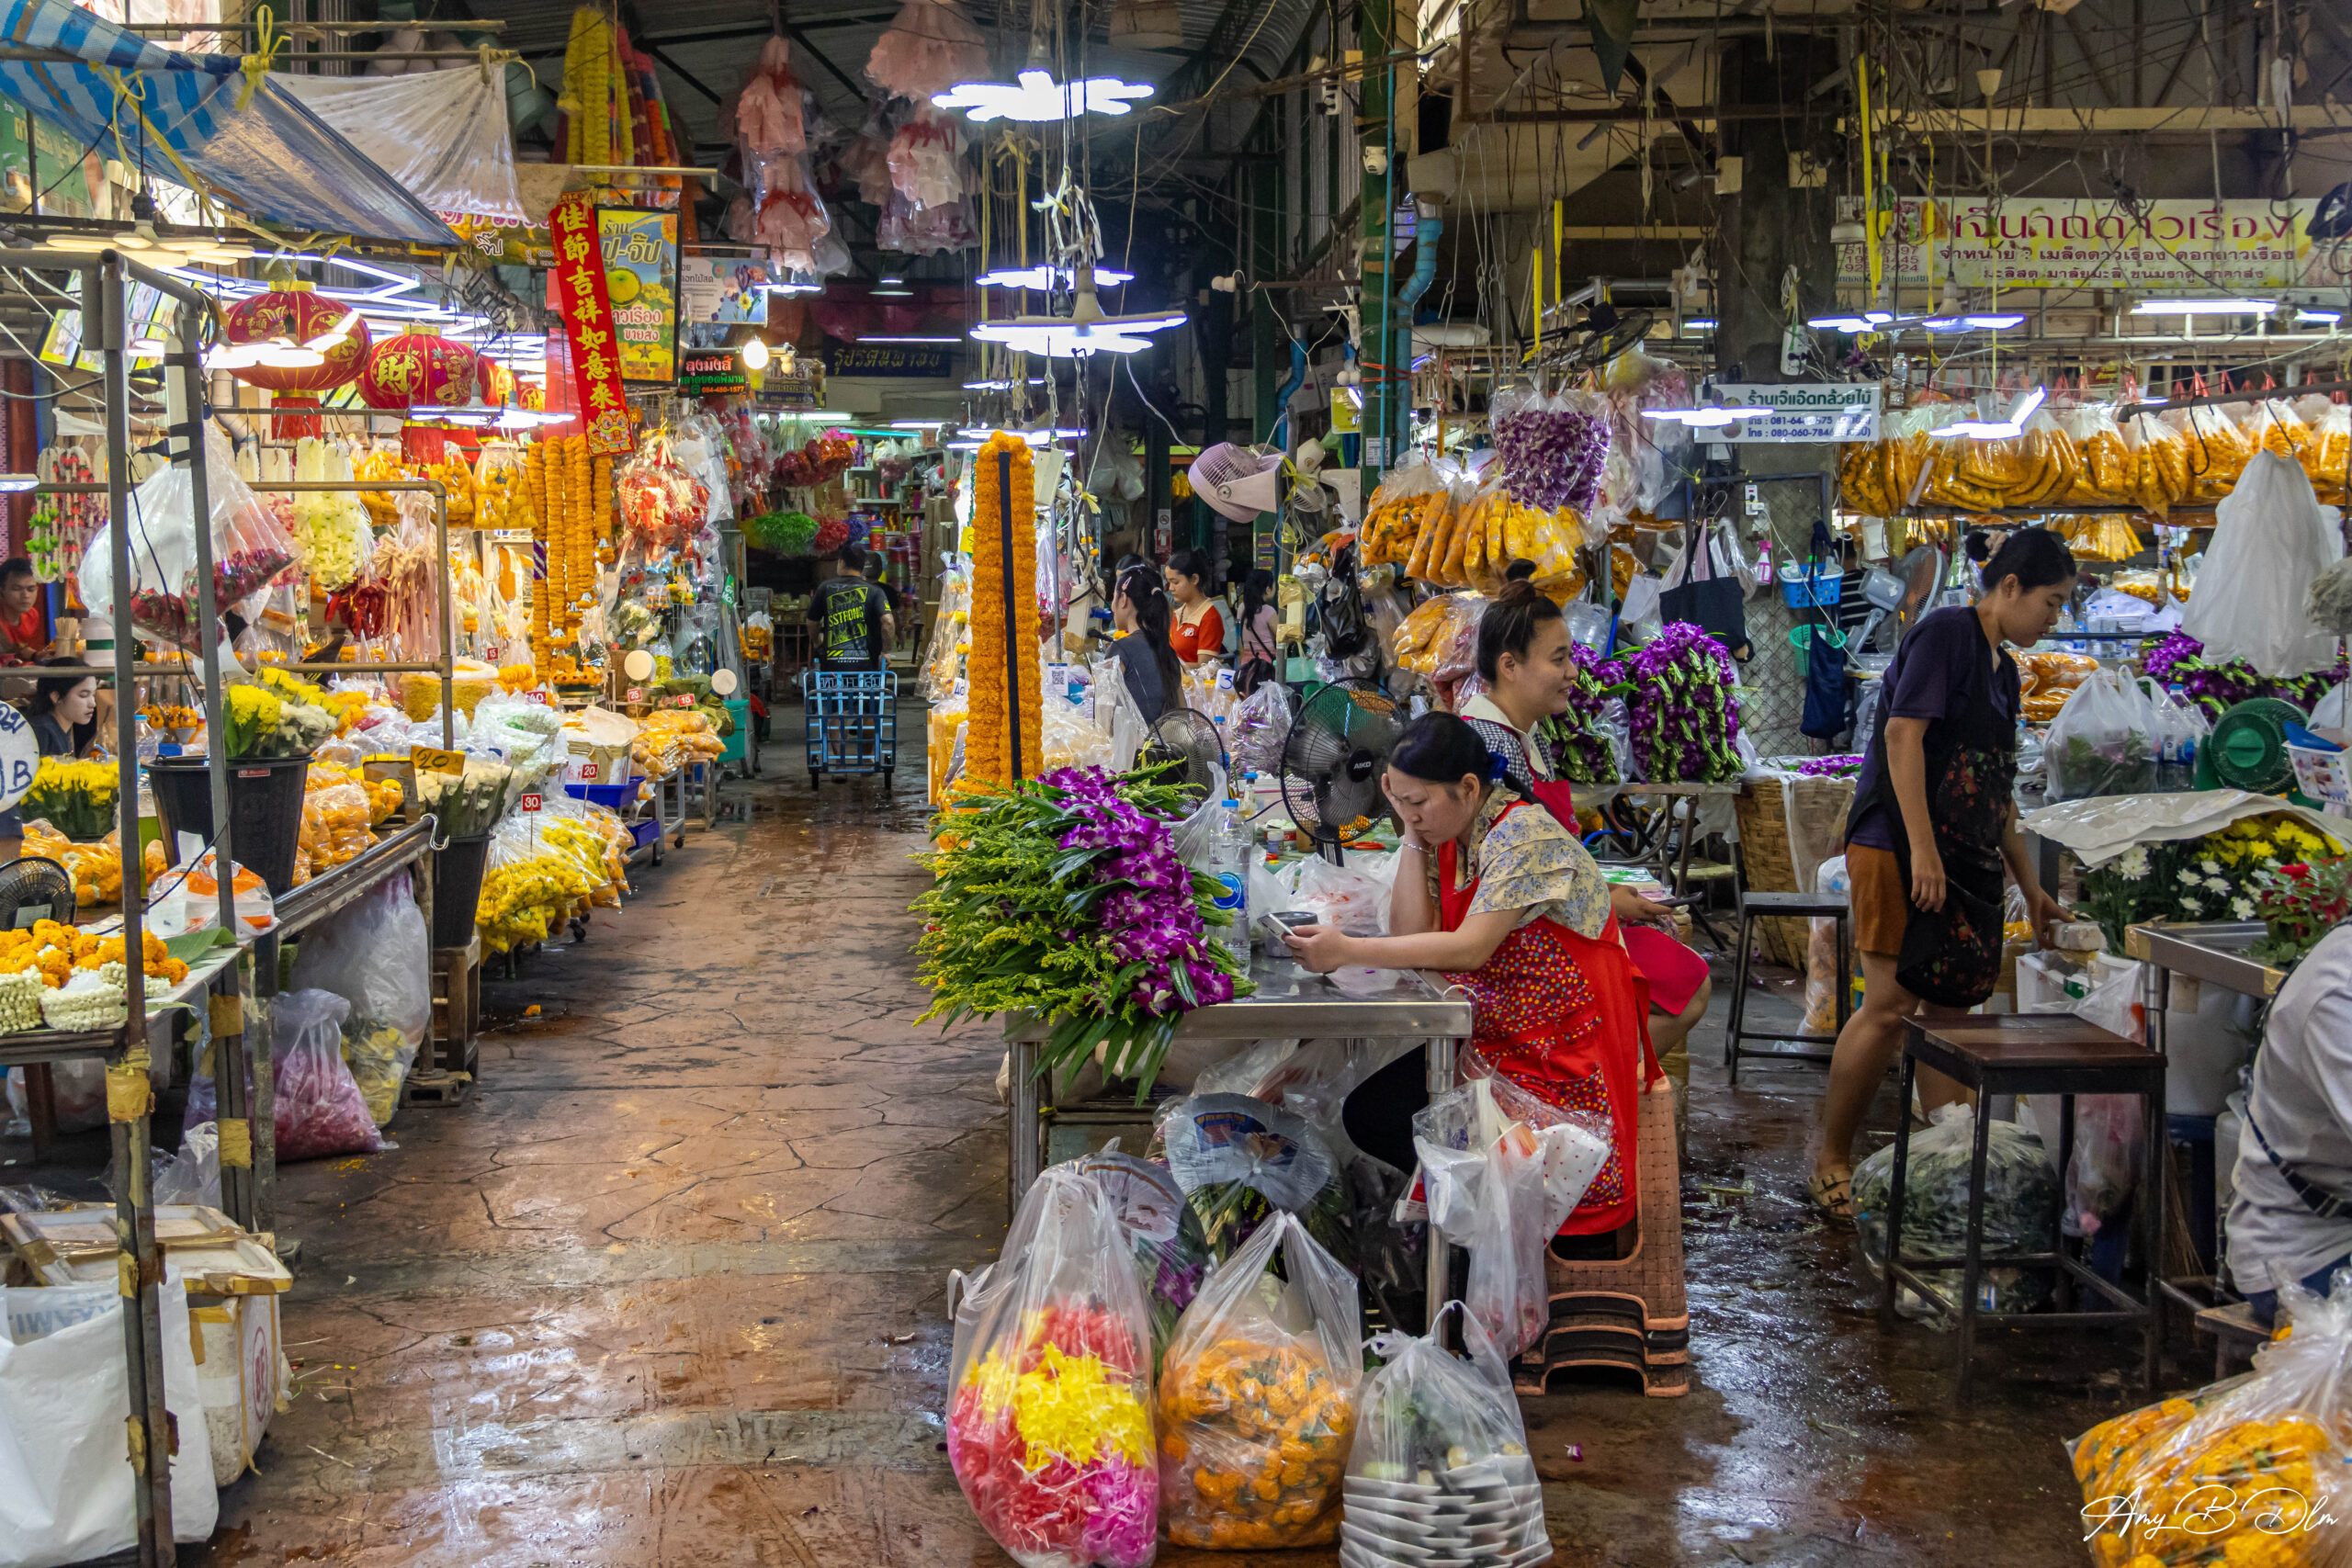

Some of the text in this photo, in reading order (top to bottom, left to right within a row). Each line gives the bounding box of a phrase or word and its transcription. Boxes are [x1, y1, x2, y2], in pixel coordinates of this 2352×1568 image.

[604, 218, 631, 235] ร้าน
[558, 204, 619, 410] 佳節吉祥如意來
[612, 306, 662, 325] าวเรือง
[623, 325, 660, 342] ขายส่ง
[378, 354, 413, 393] 財
[415, 748, 449, 770] 20
[1352, 761, 1372, 770] AIKO
